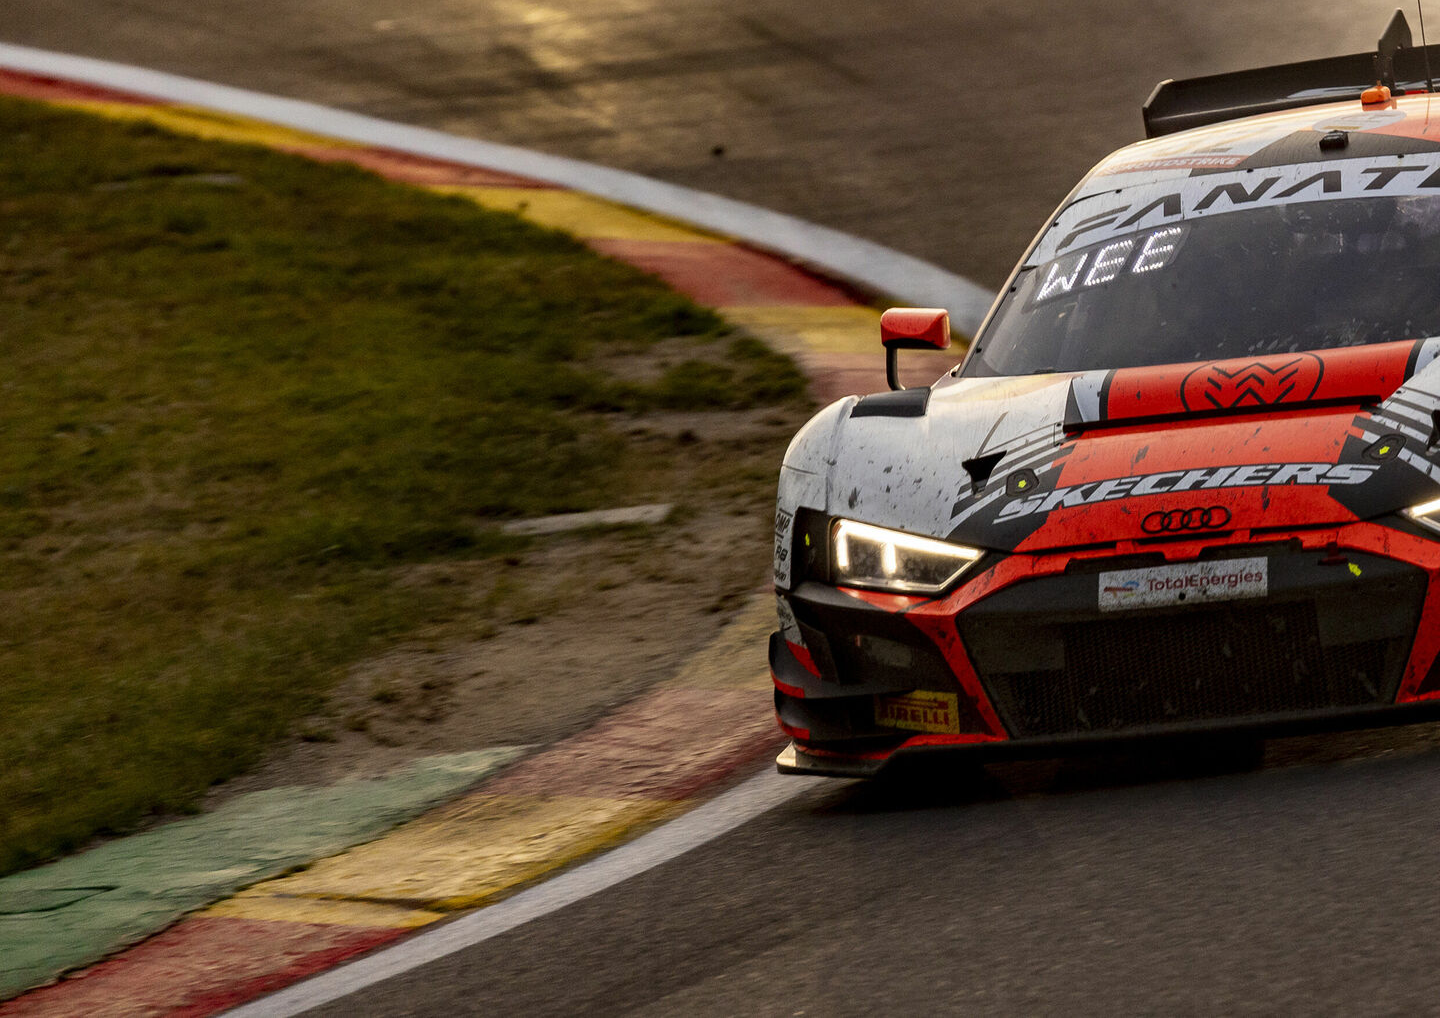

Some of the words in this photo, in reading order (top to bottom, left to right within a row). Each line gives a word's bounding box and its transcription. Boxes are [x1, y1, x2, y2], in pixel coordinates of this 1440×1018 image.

[1036, 226, 1182, 301] WEE
[992, 463, 1381, 525] SKECHERS
[1148, 569, 1263, 592] TotalEnergies
